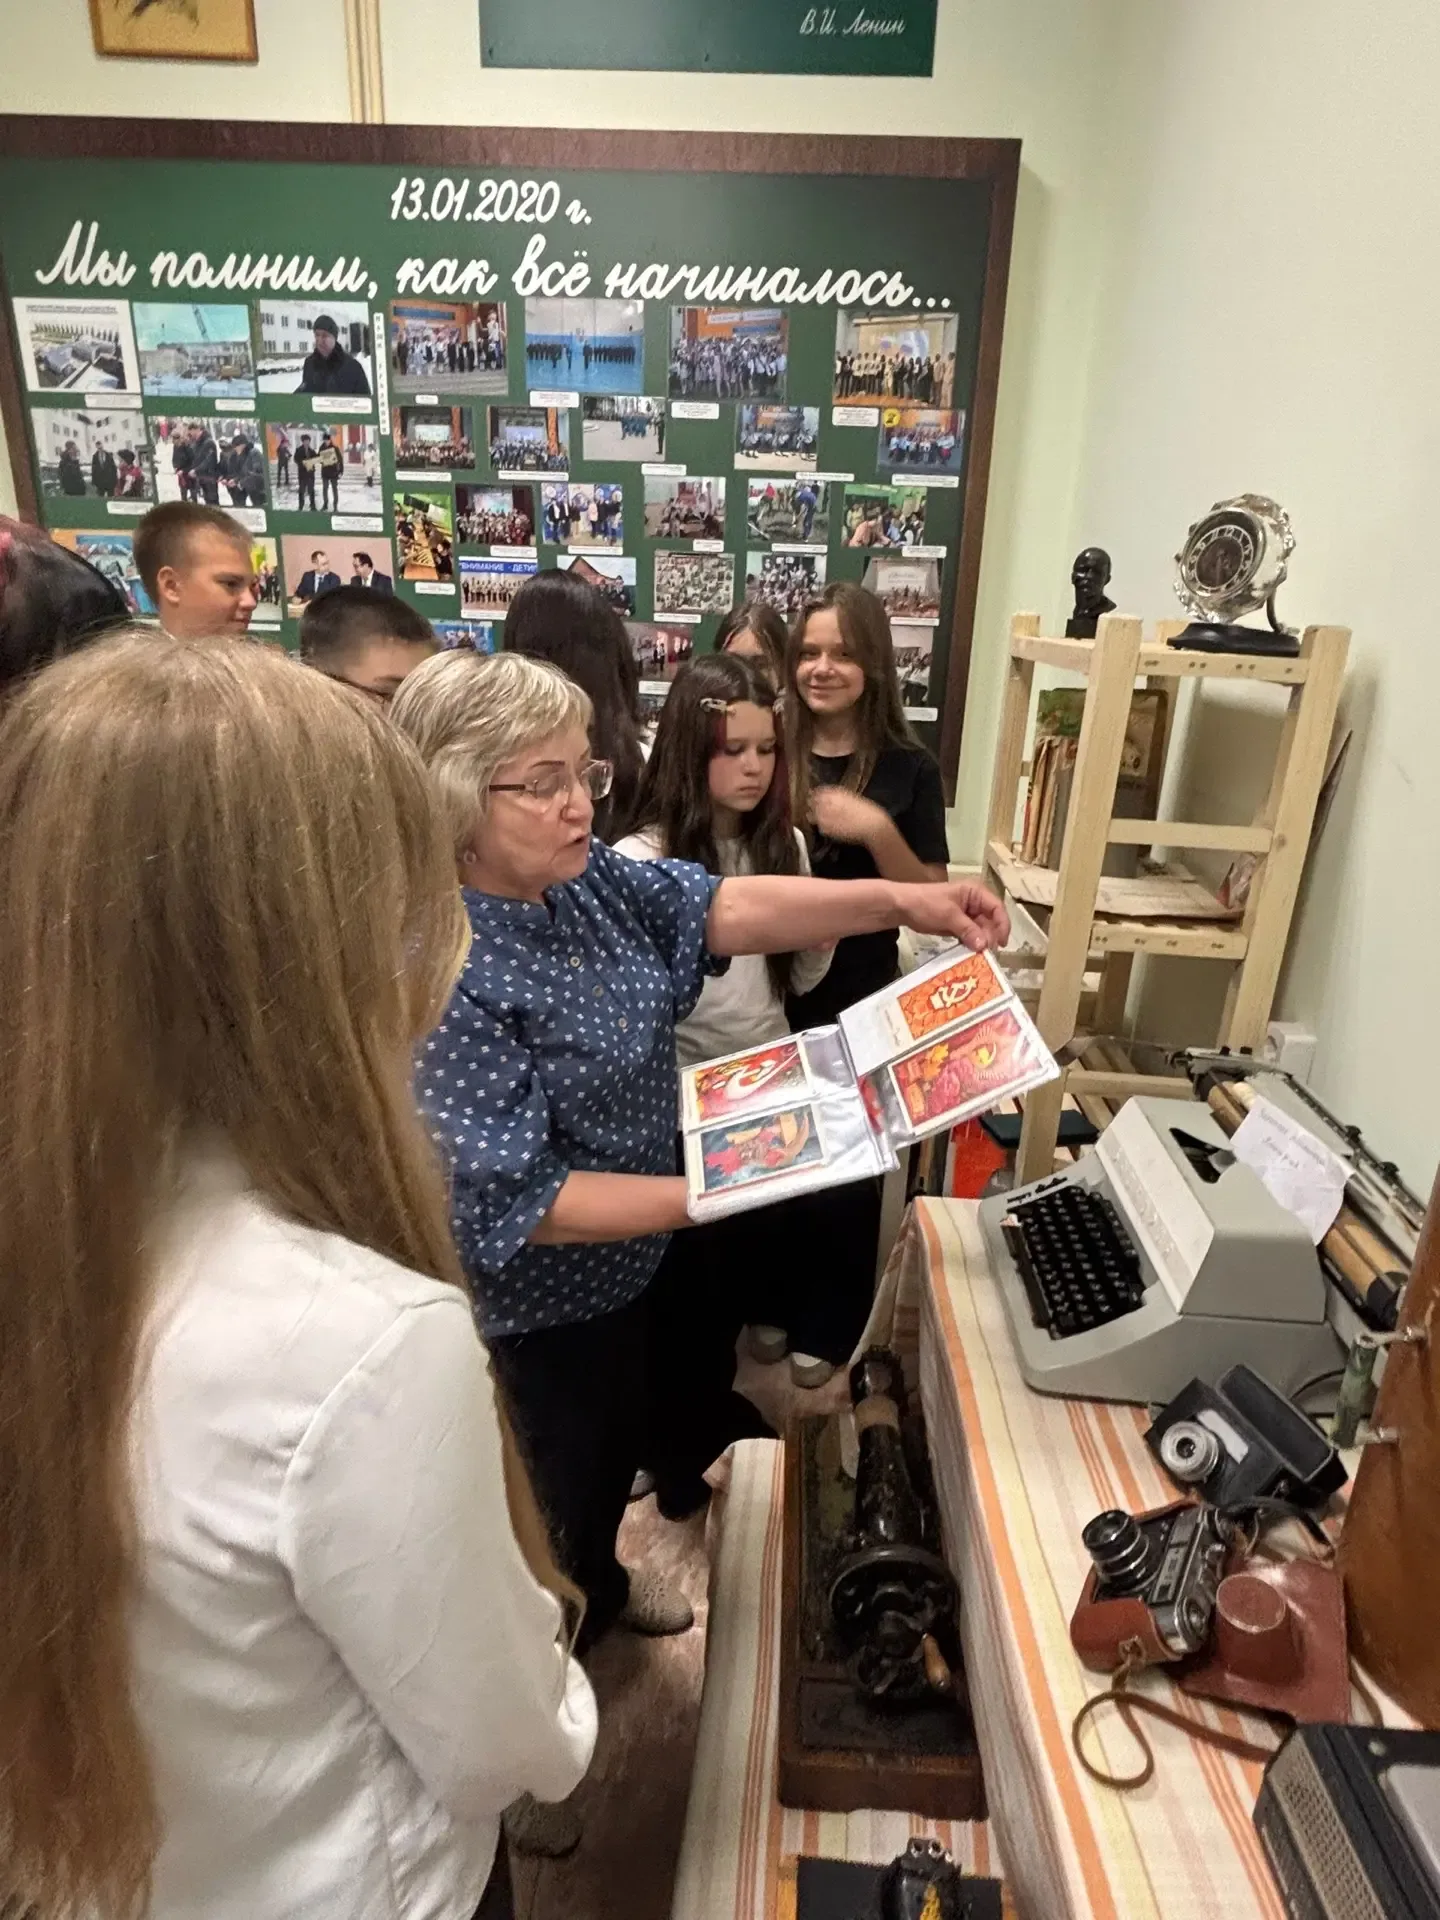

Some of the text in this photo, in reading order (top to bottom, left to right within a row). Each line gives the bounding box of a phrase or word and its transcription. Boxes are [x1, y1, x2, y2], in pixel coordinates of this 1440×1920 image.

[799, 7, 906, 35] В.И. Ленин
[391, 177, 593, 226] 13.01.2020 г.
[35, 220, 951, 308] Мы помним, как всё начиналось...
